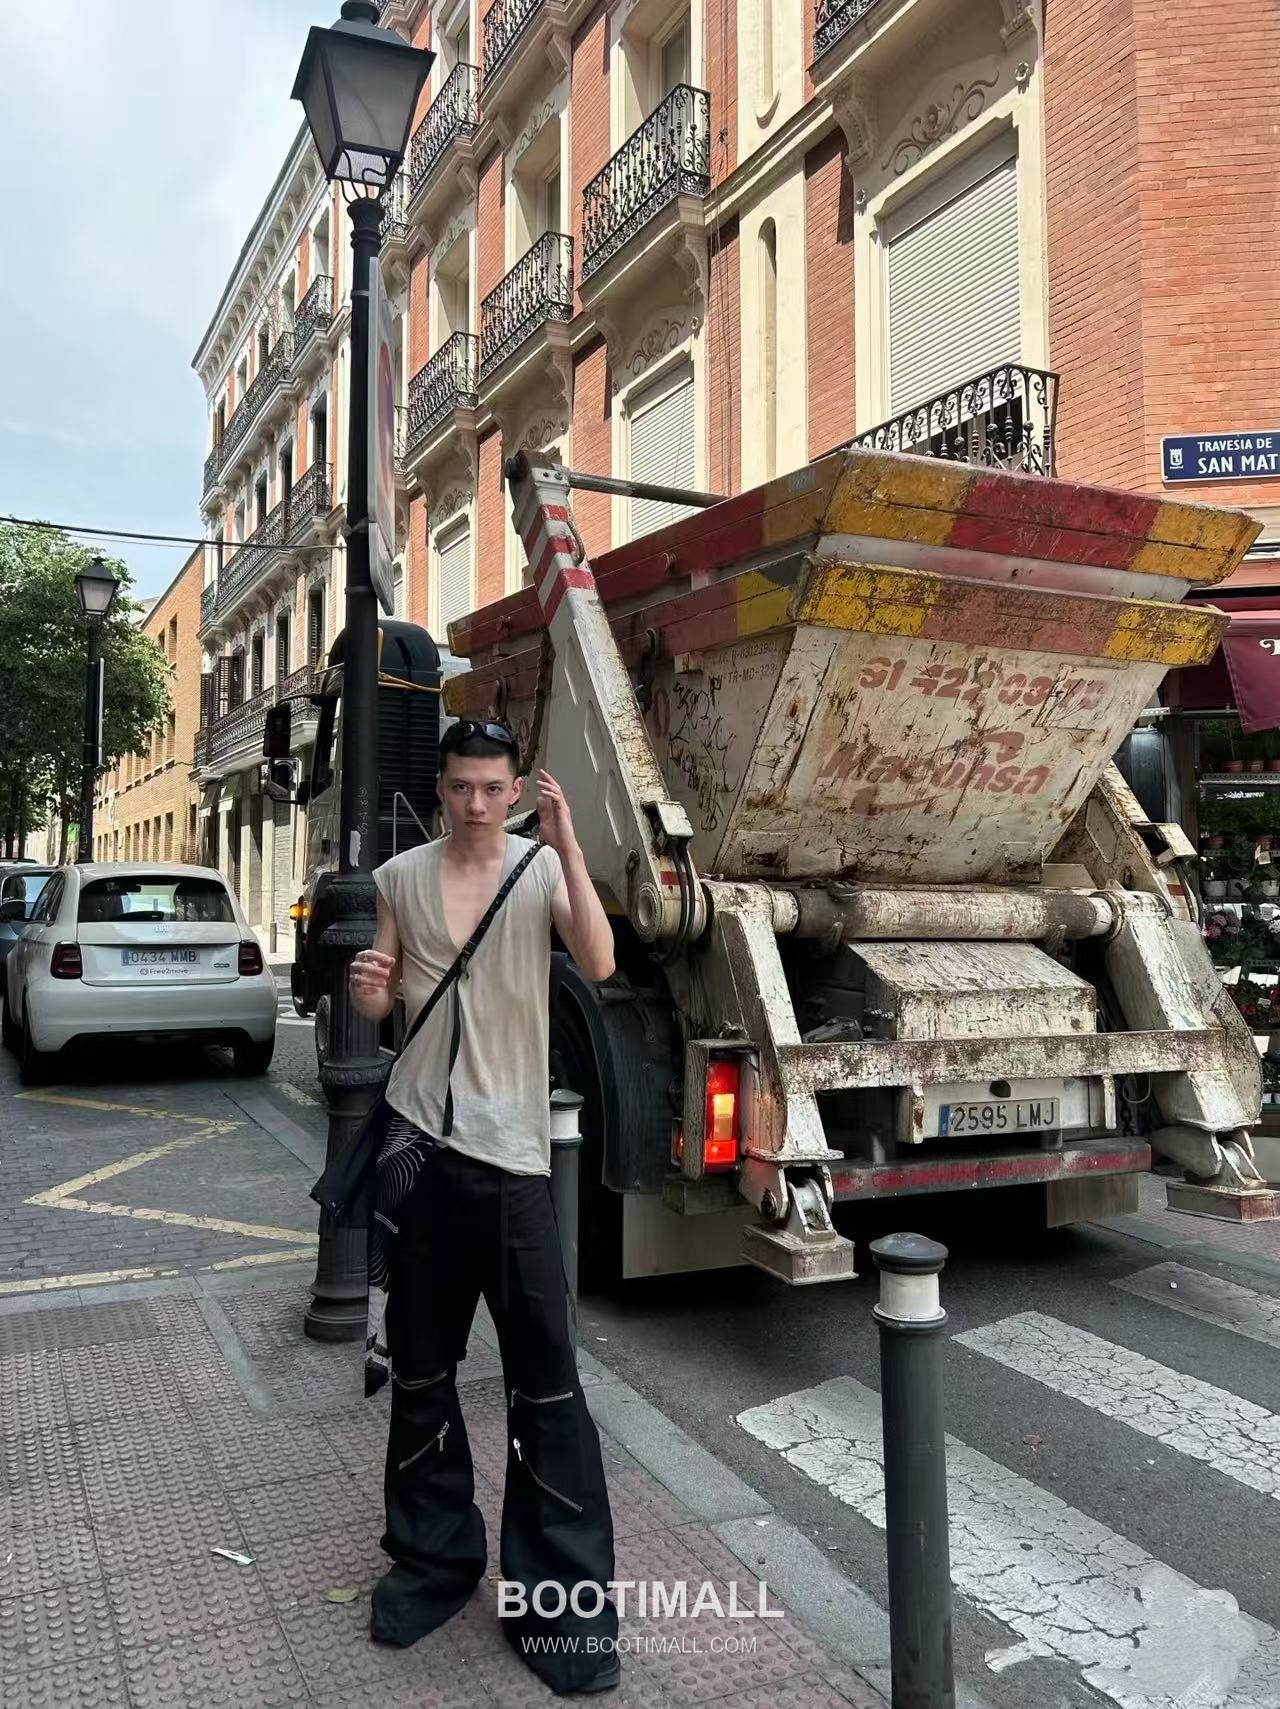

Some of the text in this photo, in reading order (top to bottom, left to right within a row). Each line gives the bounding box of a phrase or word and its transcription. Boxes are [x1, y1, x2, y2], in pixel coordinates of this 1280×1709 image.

[1197, 437, 1273, 452] TRAVESIA DE
[1198, 453, 1279, 474] SAN MAT
[131, 950, 198, 963] 0434 MMB
[953, 1101, 1055, 1132] 2595 LMJ
